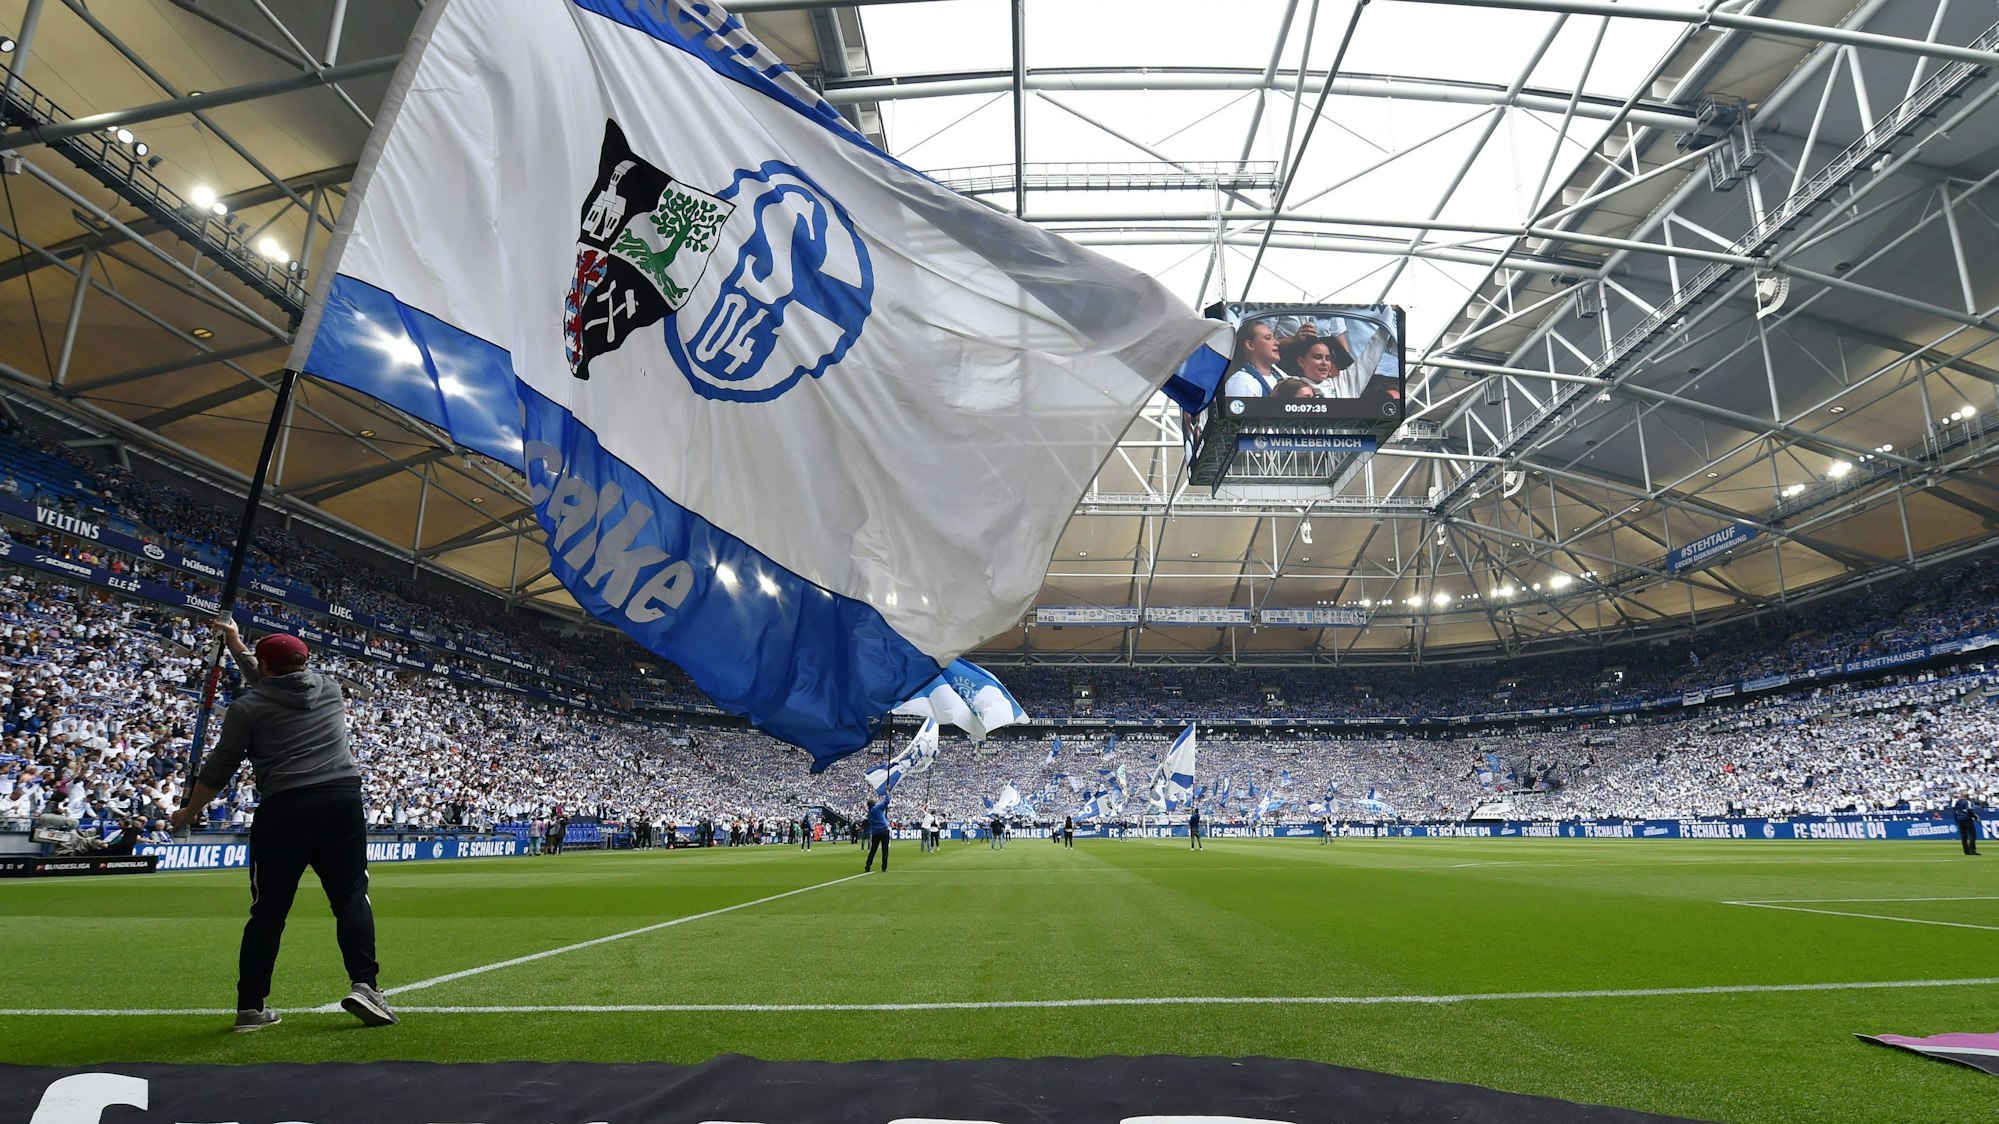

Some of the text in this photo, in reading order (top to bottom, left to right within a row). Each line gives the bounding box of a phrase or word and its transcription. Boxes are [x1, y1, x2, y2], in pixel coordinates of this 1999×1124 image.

[695, 293, 770, 375] 04
[1284, 404, 1328, 413] 00:07:35
[1270, 438, 1362, 448] WIR LEBEN DICH
[36, 506, 100, 540] VELTINS
[1681, 526, 1736, 558] #STEHTAUF
[1674, 534, 1747, 569] GEGEN DISKRIMINIERUNG
[182, 558, 216, 576] hülsta
[108, 576, 128, 590] ELE
[260, 582, 286, 597] VIVAWEST
[329, 604, 354, 620] LUEG.
[402, 657, 426, 668] Fischbach
[432, 663, 449, 675] AVG
[1847, 662, 1860, 672] DIE
[939, 828, 952, 839] 04
[1108, 828, 1119, 838] FC
[1160, 828, 1172, 838] 04
[1212, 828, 1222, 838] FC
[1262, 827, 1274, 838] 04
[1377, 827, 1388, 836] 04
[1427, 826, 1437, 836] FC
[1478, 827, 1491, 837] 04
[1522, 826, 1528, 836] FC
[1529, 826, 1550, 836] SCHALKE
[1552, 826, 1560, 836] 04
[1585, 826, 1594, 837] FC
[1594, 826, 1622, 838] SCHALKE
[1624, 826, 1634, 838] 04
[1680, 824, 1690, 838] FC
[1692, 824, 1730, 838] SCHALKE
[1732, 824, 1746, 838] 04
[1793, 822, 1886, 838] FC SCHALKE 04
[223, 844, 248, 867] 04
[366, 842, 416, 862] HALKE 04
[458, 840, 516, 858] FC SCHALKE 04
